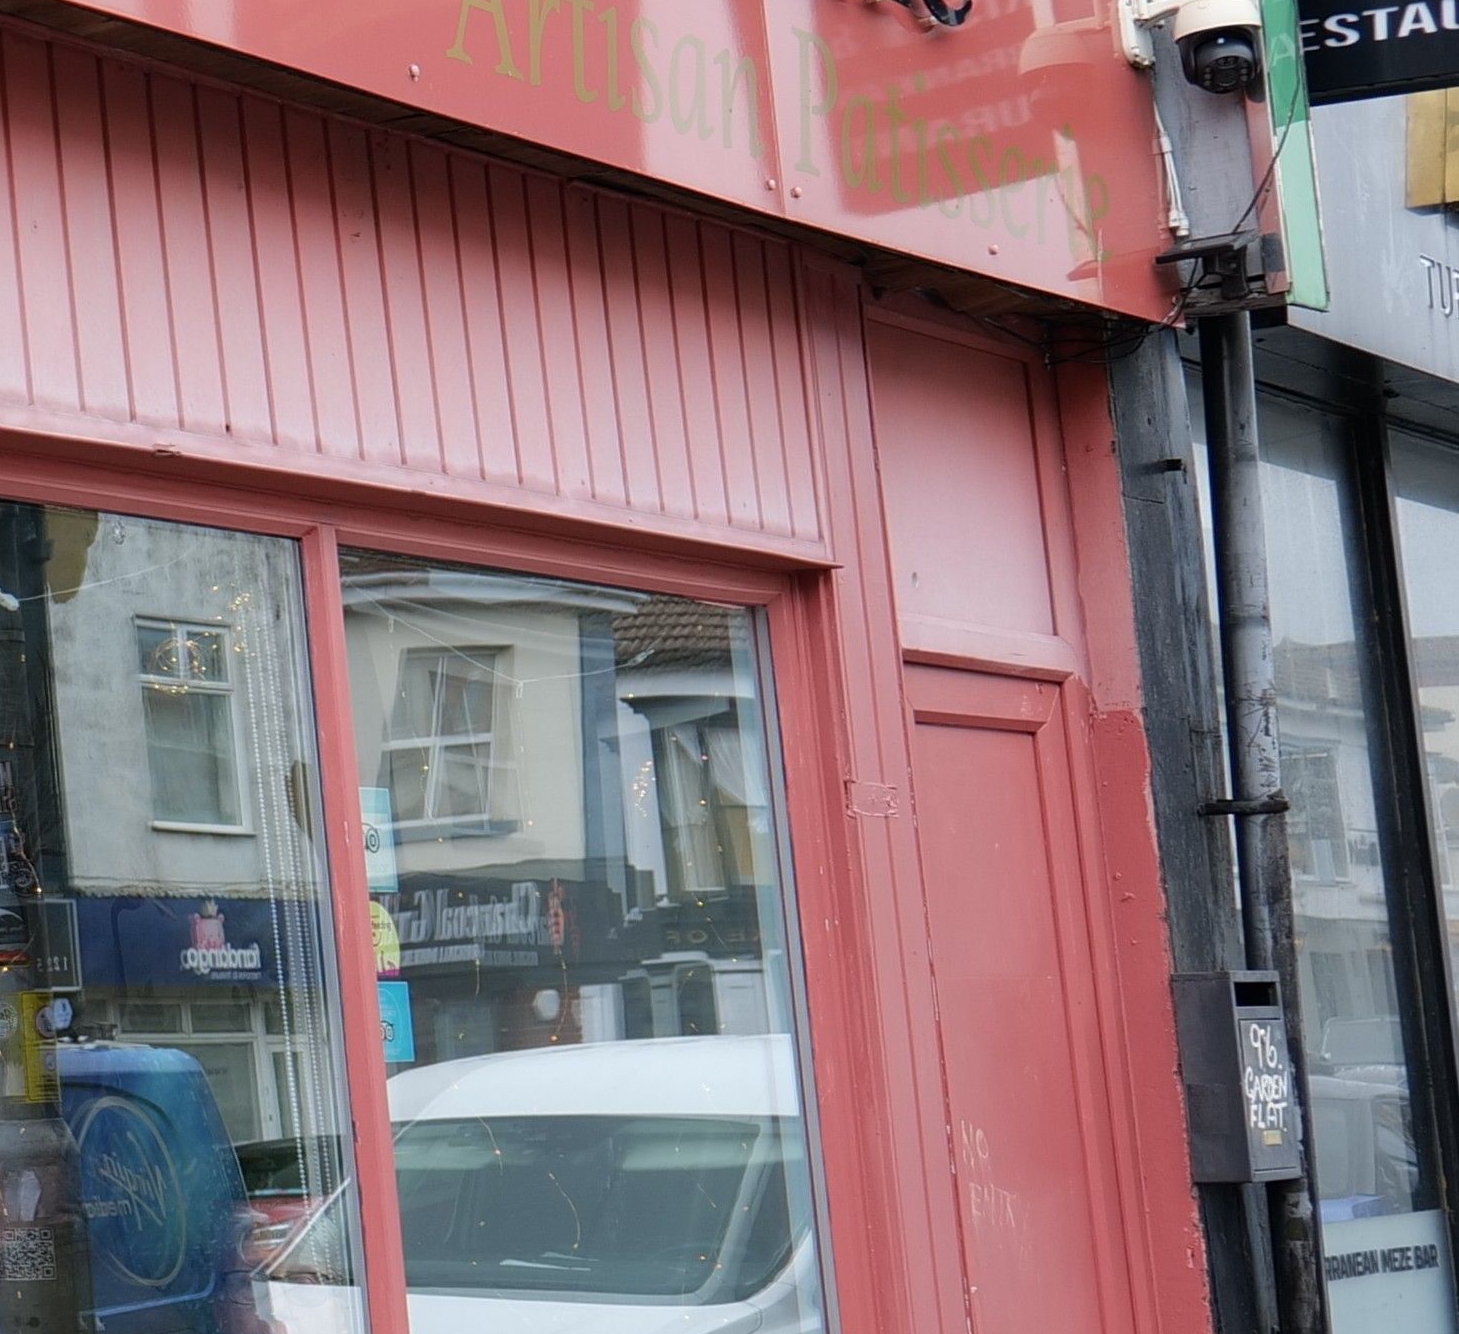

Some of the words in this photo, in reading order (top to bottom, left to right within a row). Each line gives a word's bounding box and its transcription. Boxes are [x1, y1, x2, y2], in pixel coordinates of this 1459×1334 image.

[791, 27, 1112, 264] Patisserie
[1244, 1067, 1288, 1102] GARDEN
[960, 1119, 990, 1170] NO
[1380, 1246, 1414, 1273] MEZE
[1414, 1244, 1440, 1270] BAR
